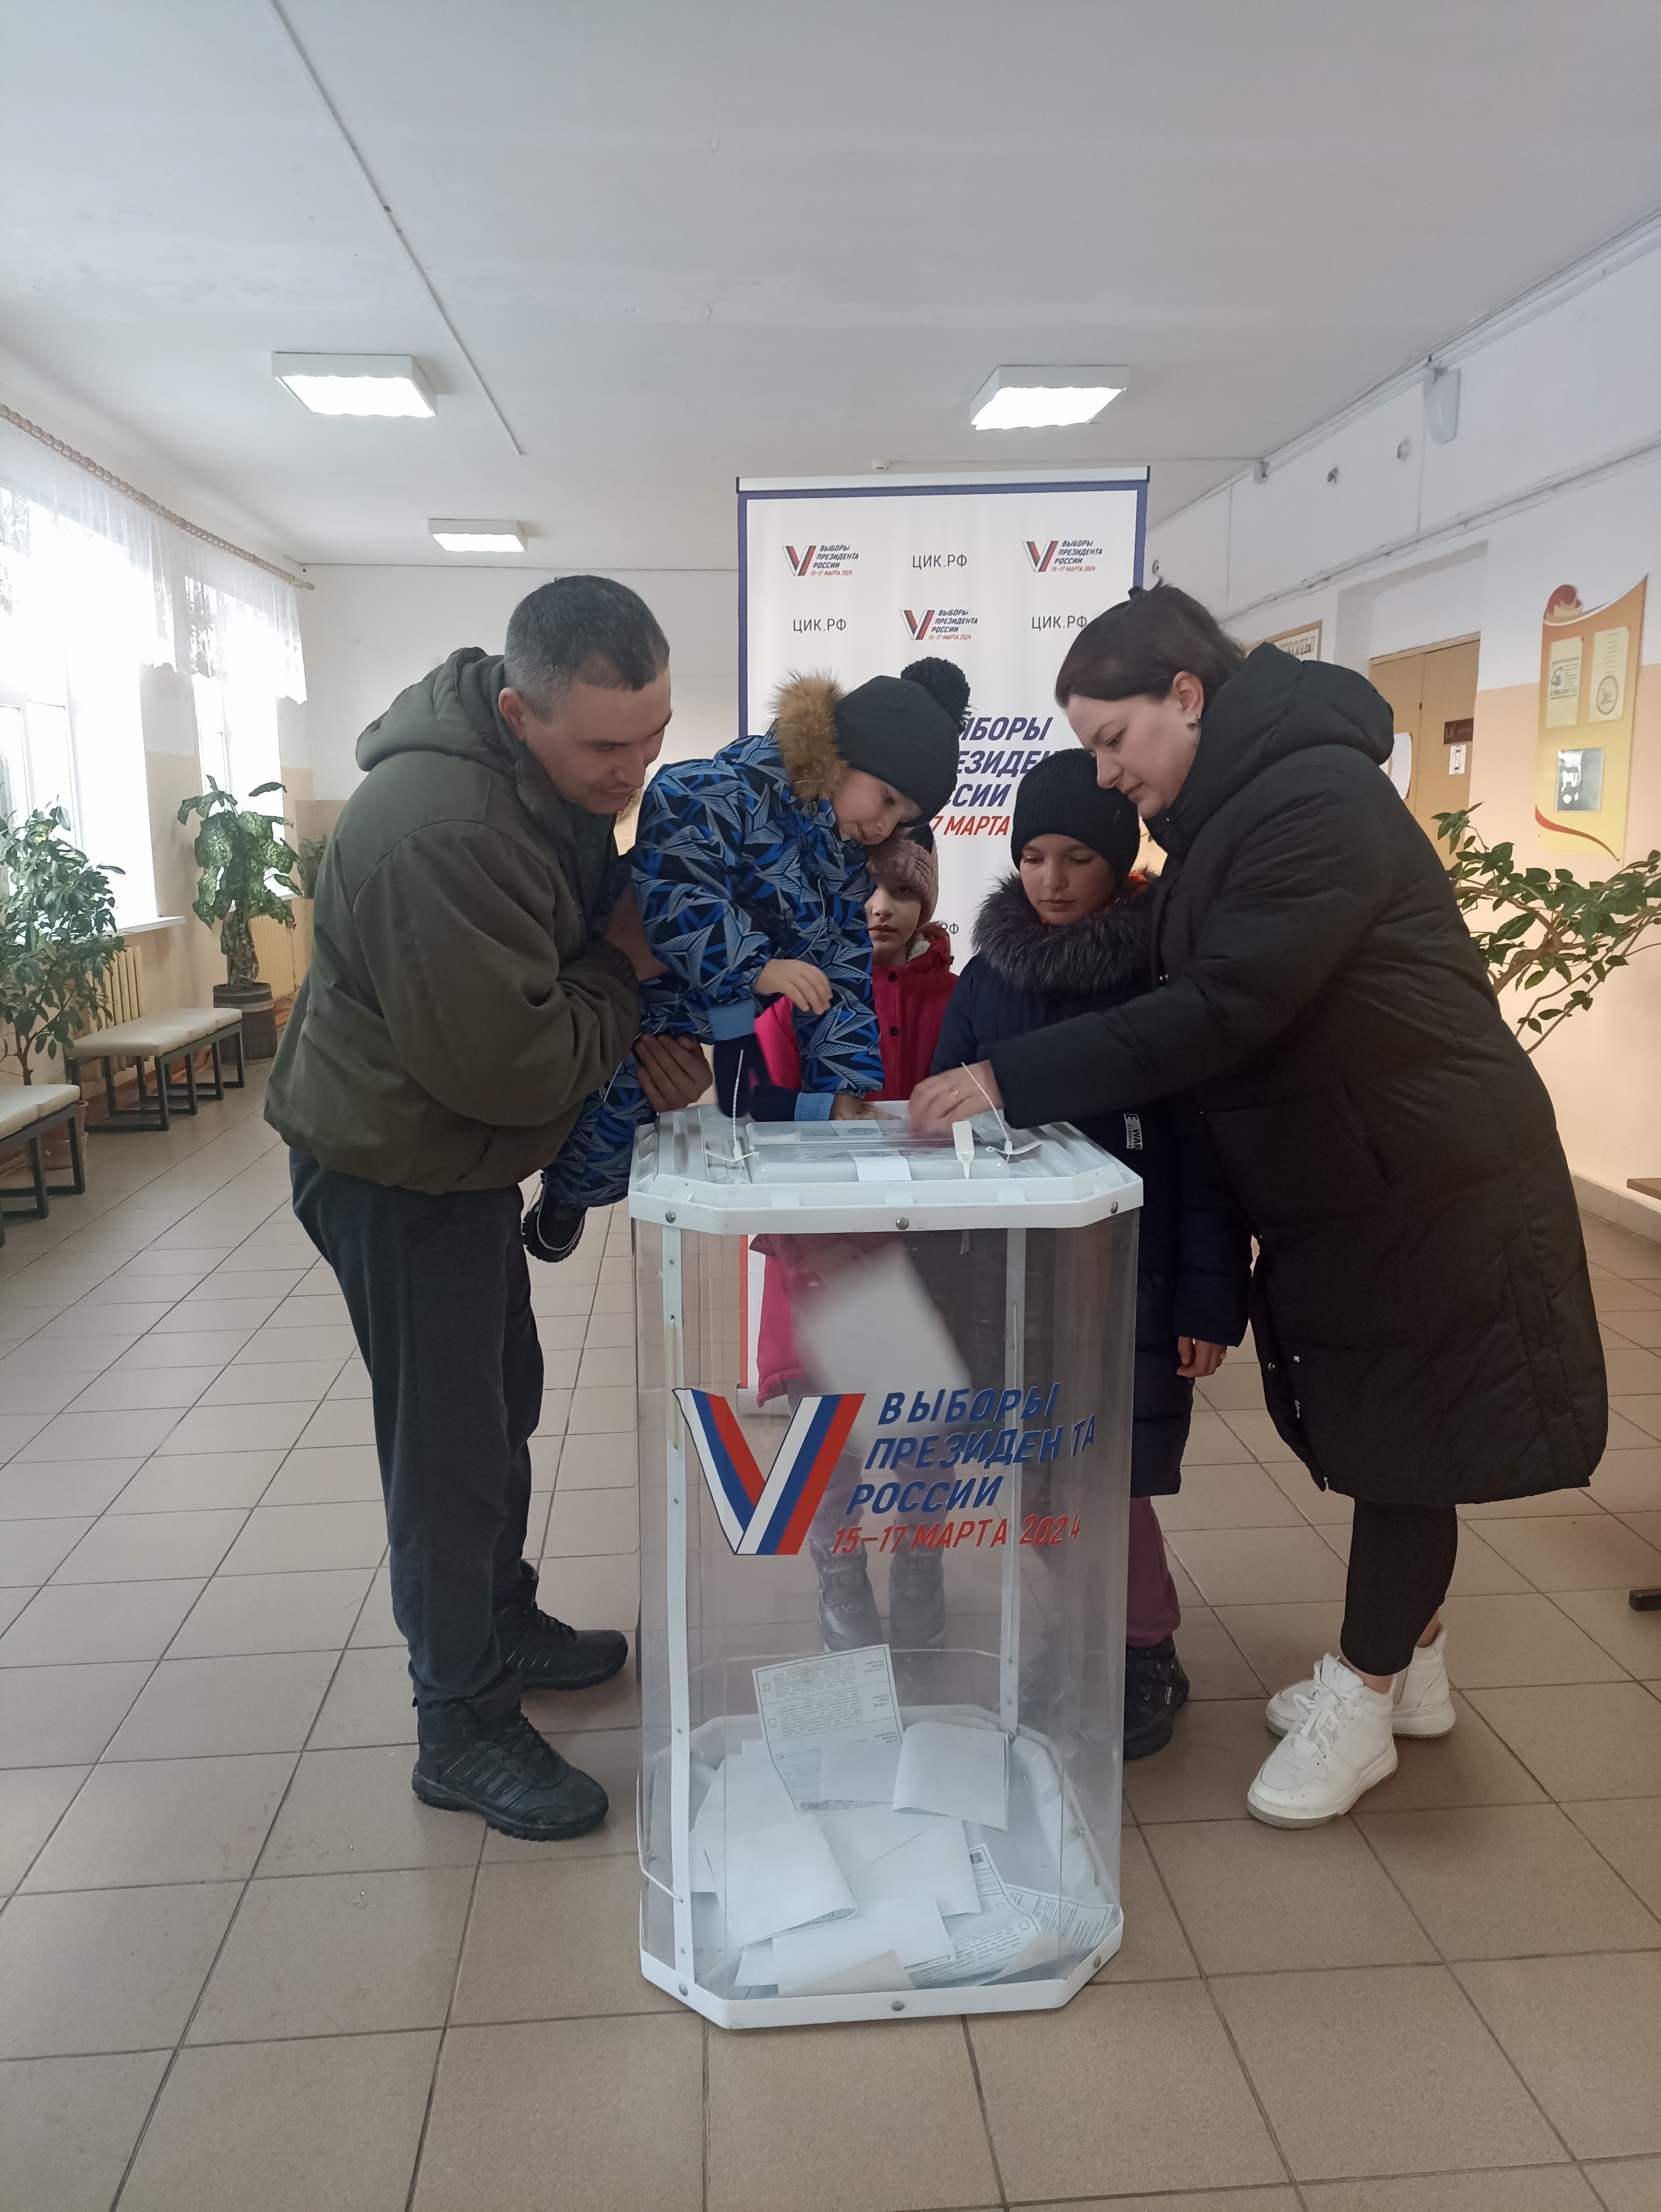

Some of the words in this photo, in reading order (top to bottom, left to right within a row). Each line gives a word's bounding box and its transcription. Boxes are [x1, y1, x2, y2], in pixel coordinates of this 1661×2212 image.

[913, 554, 967, 570] ЦИК.РФ
[793, 618, 846, 633] ЦИК.РФ
[1032, 615, 1087, 631] ЦИК.РФ
[961, 717, 1053, 741] БОРЫ
[957, 751, 1061, 778] ЕЗИДЕ
[946, 784, 1012, 807] СИИ
[943, 816, 1010, 836] МАРТА
[877, 1382, 1061, 1425] ВЫБОРЫ
[845, 1476, 1004, 1515] РОССИИ
[910, 1518, 1007, 1550] МАРТА
[1019, 1511, 1081, 1546] 2024
